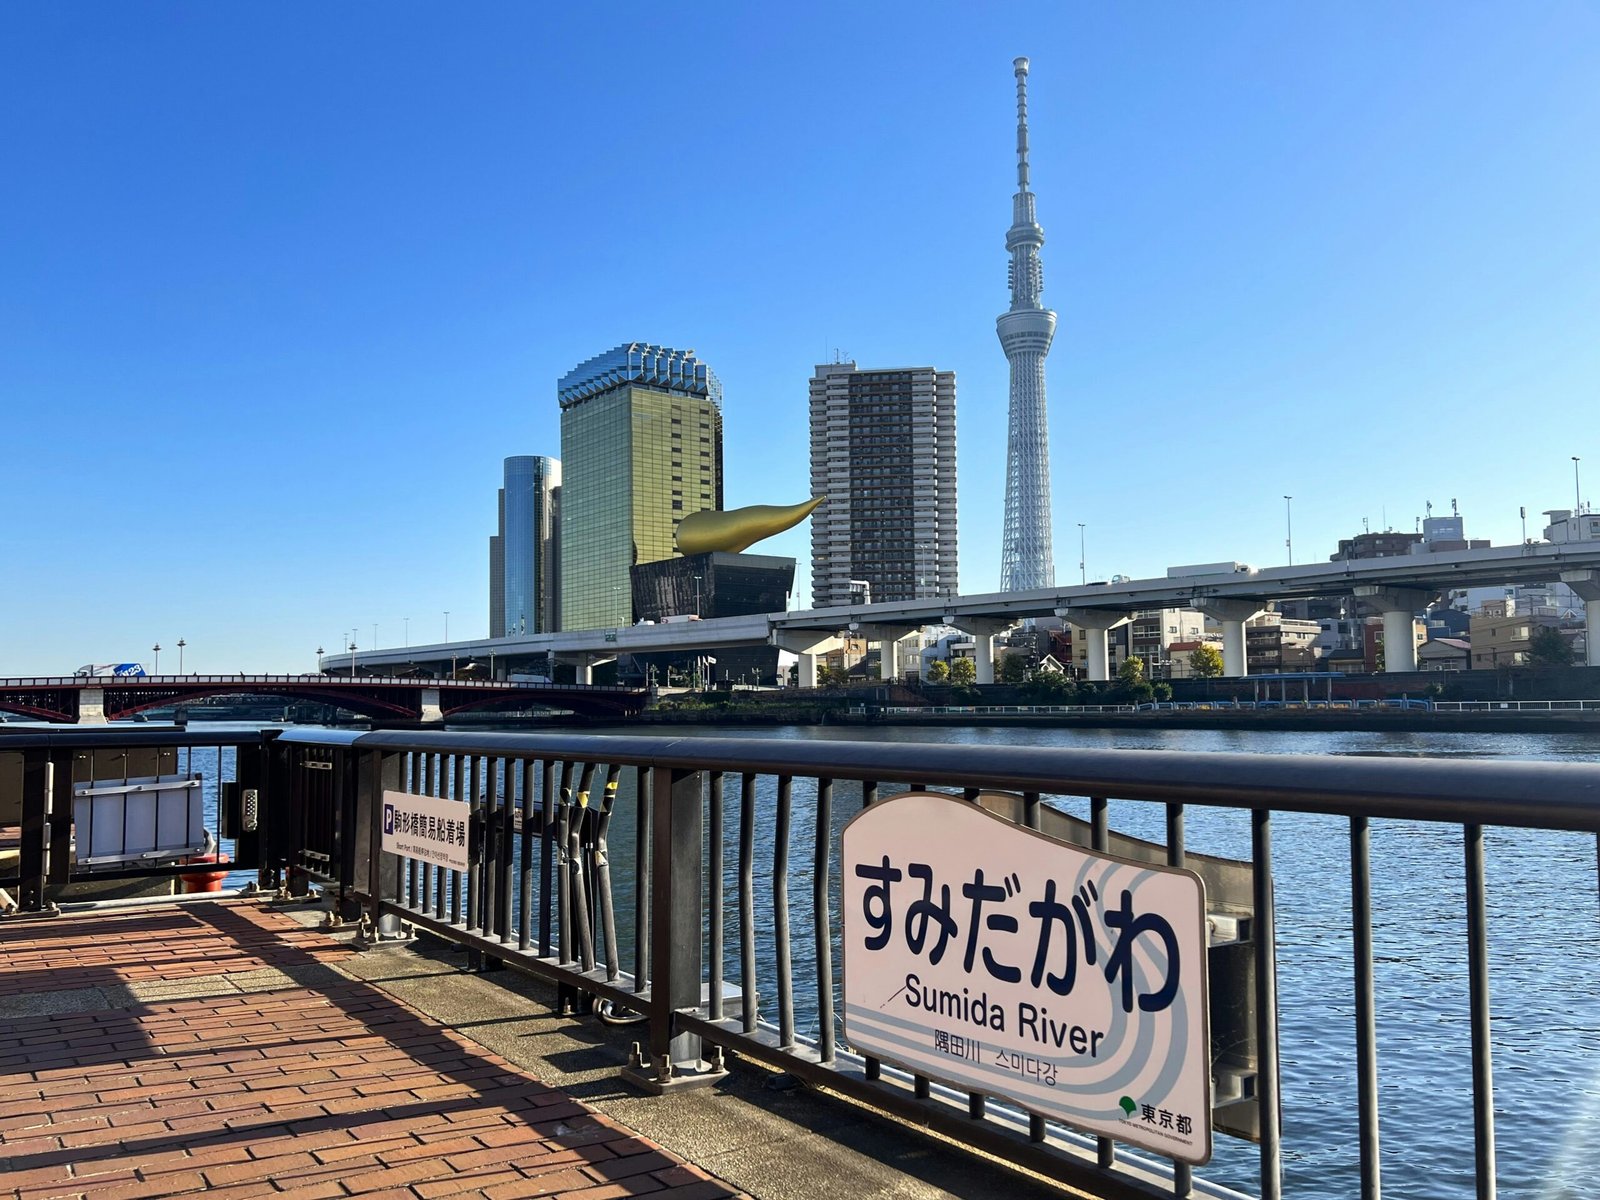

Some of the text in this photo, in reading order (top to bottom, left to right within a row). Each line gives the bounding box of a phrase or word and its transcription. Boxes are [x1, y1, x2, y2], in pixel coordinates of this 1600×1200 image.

[394, 809, 465, 847] 駒形橋簡易船着場
[855, 855, 1180, 1013] すみだがわ
[905, 974, 1104, 1058] Sumida River
[935, 1029, 980, 1064] 隅田川
[995, 1049, 1058, 1086] 스미다강
[1118, 1118, 1193, 1146] TOKYO METROPOLITAN GOVERNMENT
[1141, 1103, 1192, 1136] 東京都
